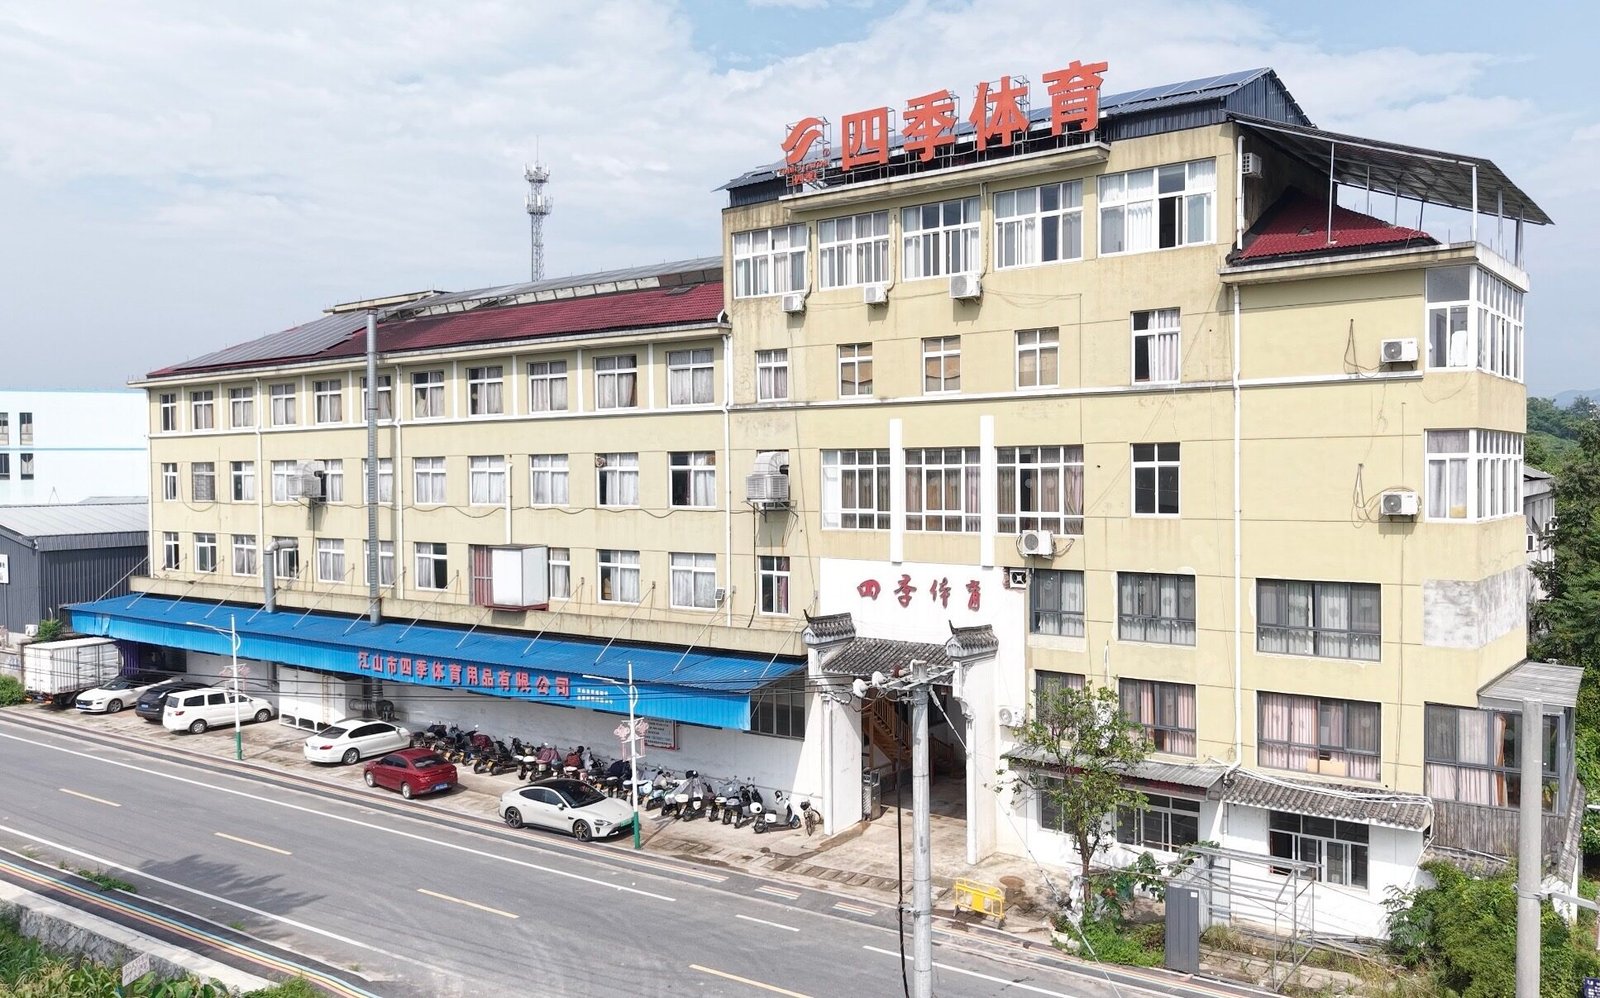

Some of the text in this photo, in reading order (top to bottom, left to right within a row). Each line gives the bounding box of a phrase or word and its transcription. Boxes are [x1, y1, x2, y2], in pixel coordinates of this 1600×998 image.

[842, 60, 1108, 171] 四季体育
[857, 574, 980, 611] 四季体育
[358, 651, 570, 698] 江山市四季体育用品有限公司
